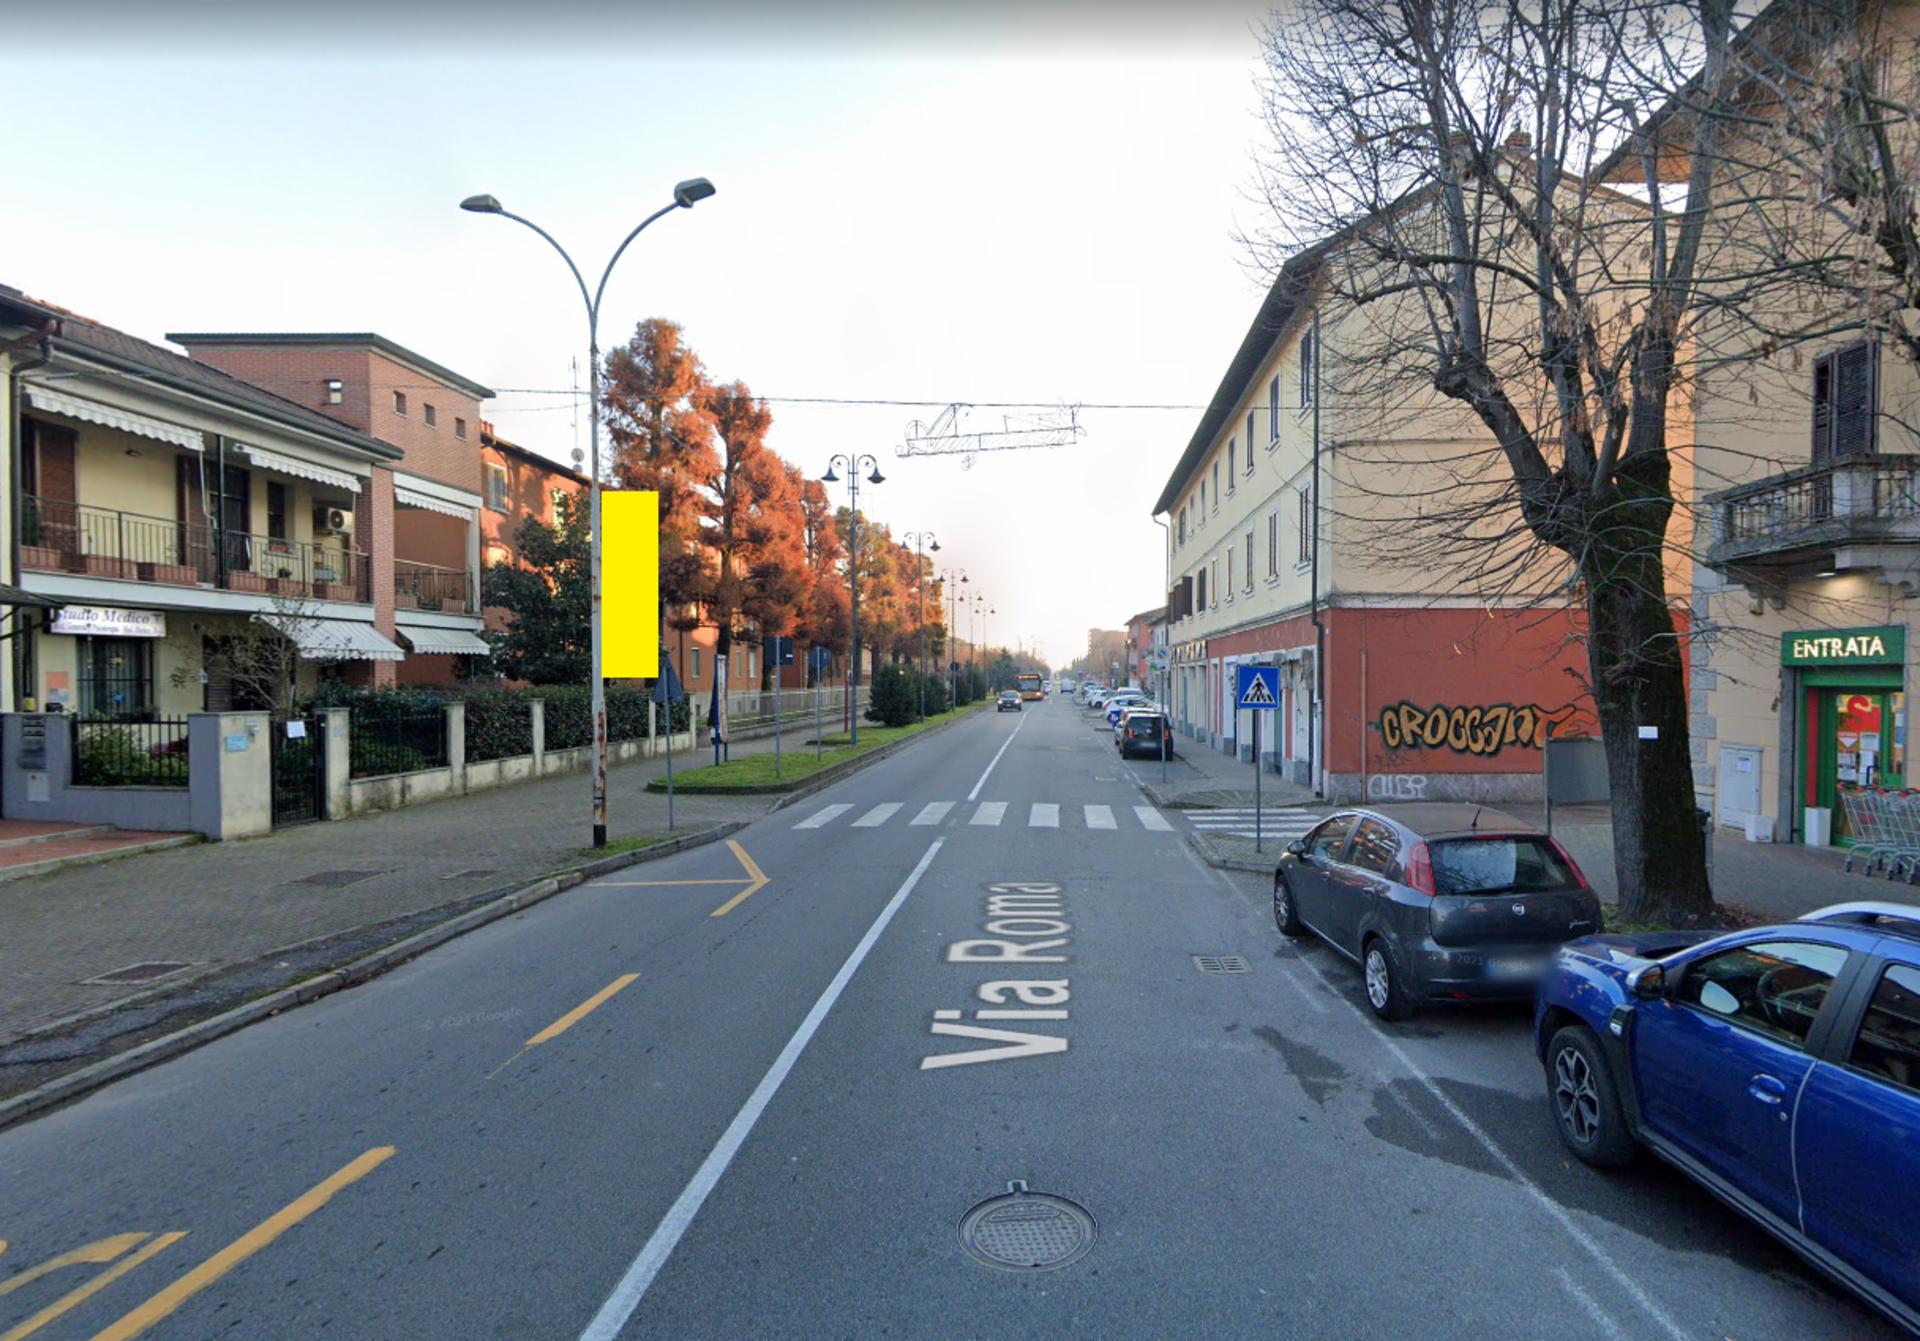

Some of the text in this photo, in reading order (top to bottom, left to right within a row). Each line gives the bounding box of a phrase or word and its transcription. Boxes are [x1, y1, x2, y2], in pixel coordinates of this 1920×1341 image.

[56, 607, 150, 624] Studio Medico
[1793, 634, 1886, 658] ENTRATA
